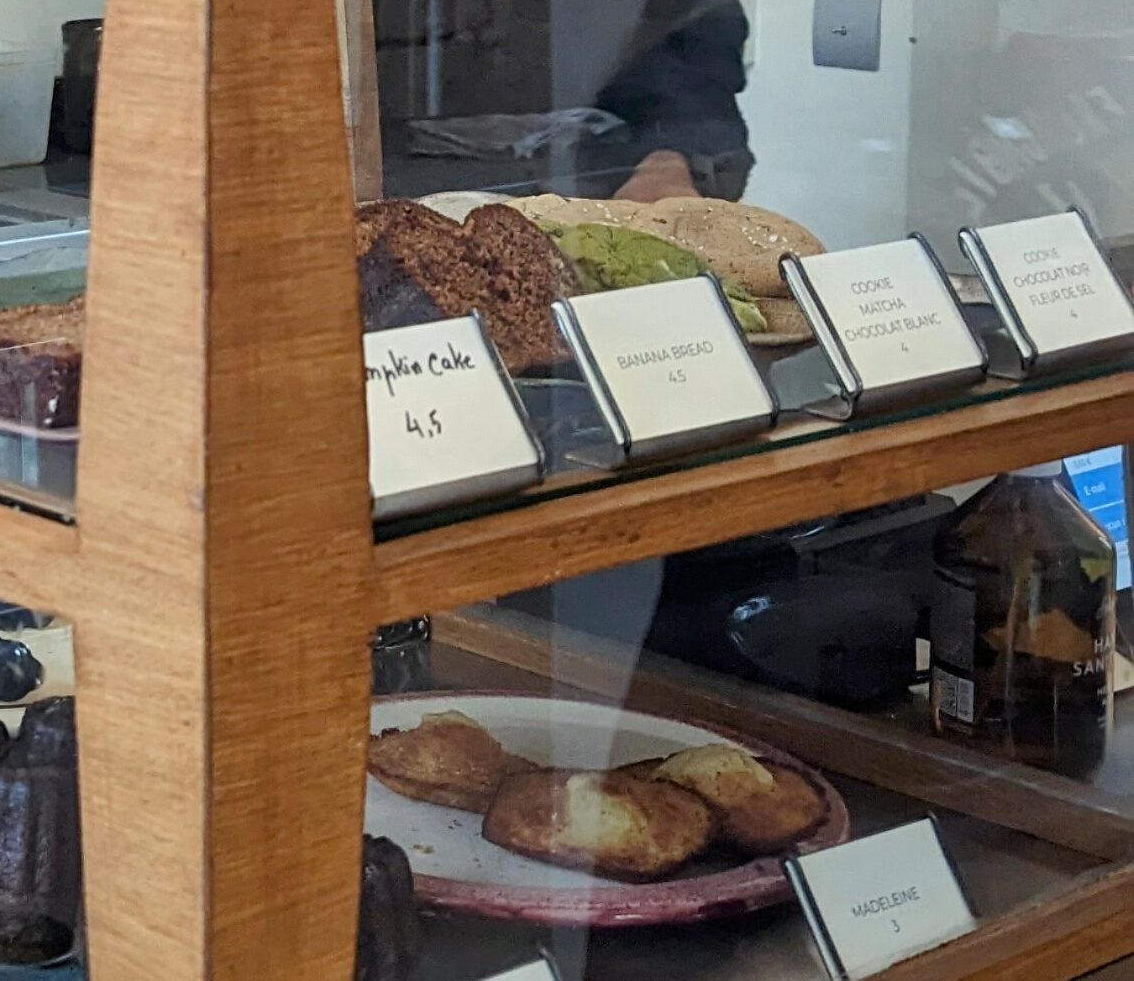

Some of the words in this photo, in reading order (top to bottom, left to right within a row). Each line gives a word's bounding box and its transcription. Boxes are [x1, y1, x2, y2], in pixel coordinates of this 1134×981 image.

[850, 277, 894, 295] COOKIE
[1013, 267, 1064, 288] CHOCOLAT
[1061, 286, 1078, 300] DE
[859, 297, 906, 316] MATCHA
[1070, 308, 1078, 318] 4
[845, 320, 903, 342] CHOCOLAT
[902, 313, 942, 331] BLANC
[617, 348, 672, 370] BANANA
[670, 340, 714, 360] BREAD
[901, 342, 909, 352] 4
[405, 409, 442, 438] 4,5
[851, 885, 920, 917] MADELEINE
[891, 919, 900, 933] 3
